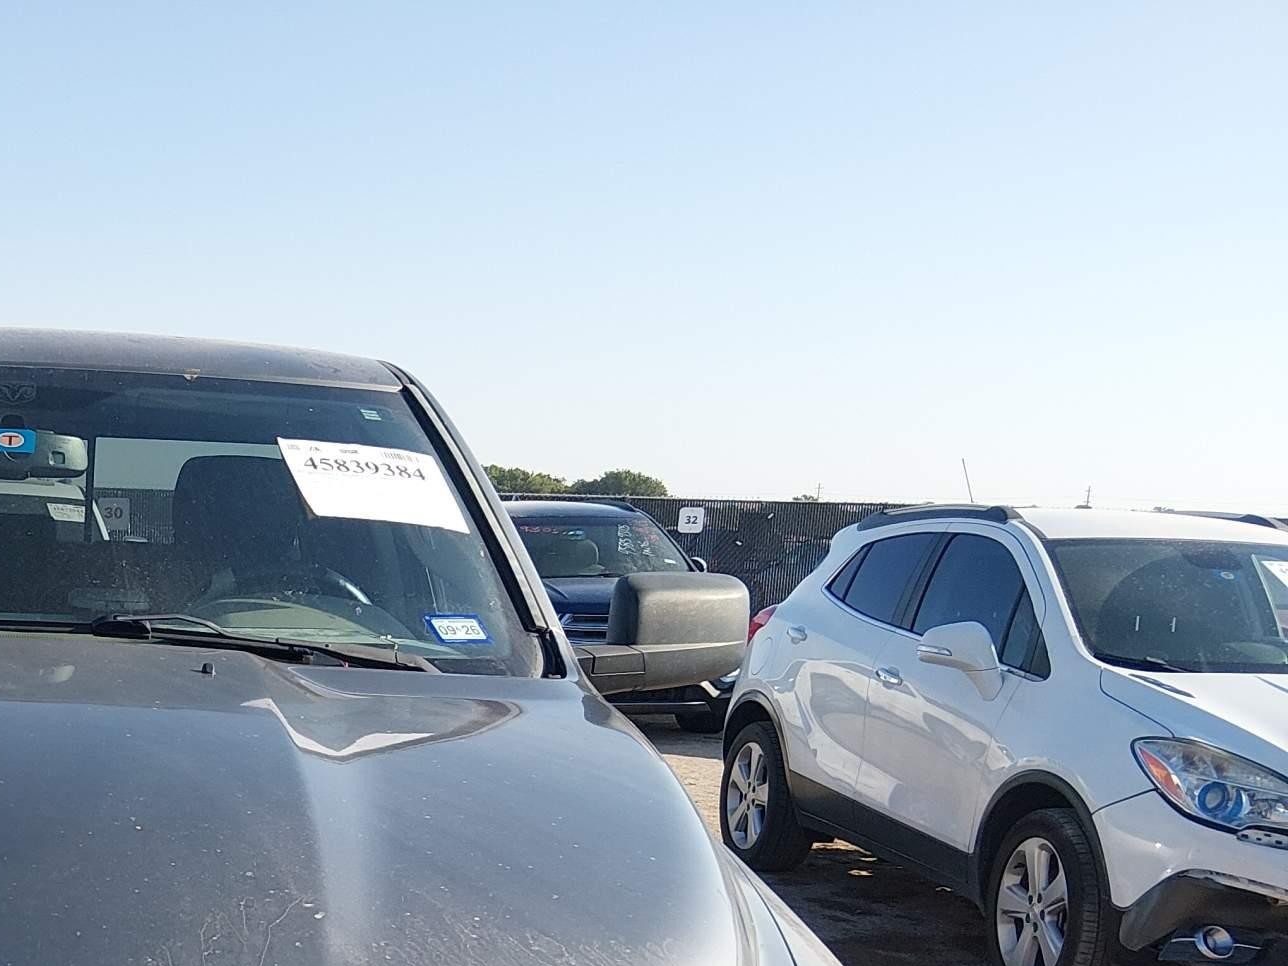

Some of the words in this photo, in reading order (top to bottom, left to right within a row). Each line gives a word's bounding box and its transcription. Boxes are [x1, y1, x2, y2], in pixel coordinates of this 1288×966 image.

[303, 456, 426, 481] 45839384
[104, 506, 123, 519] 30
[684, 515, 698, 525] 32
[438, 624, 457, 635] 09
[464, 624, 481, 635] 26
